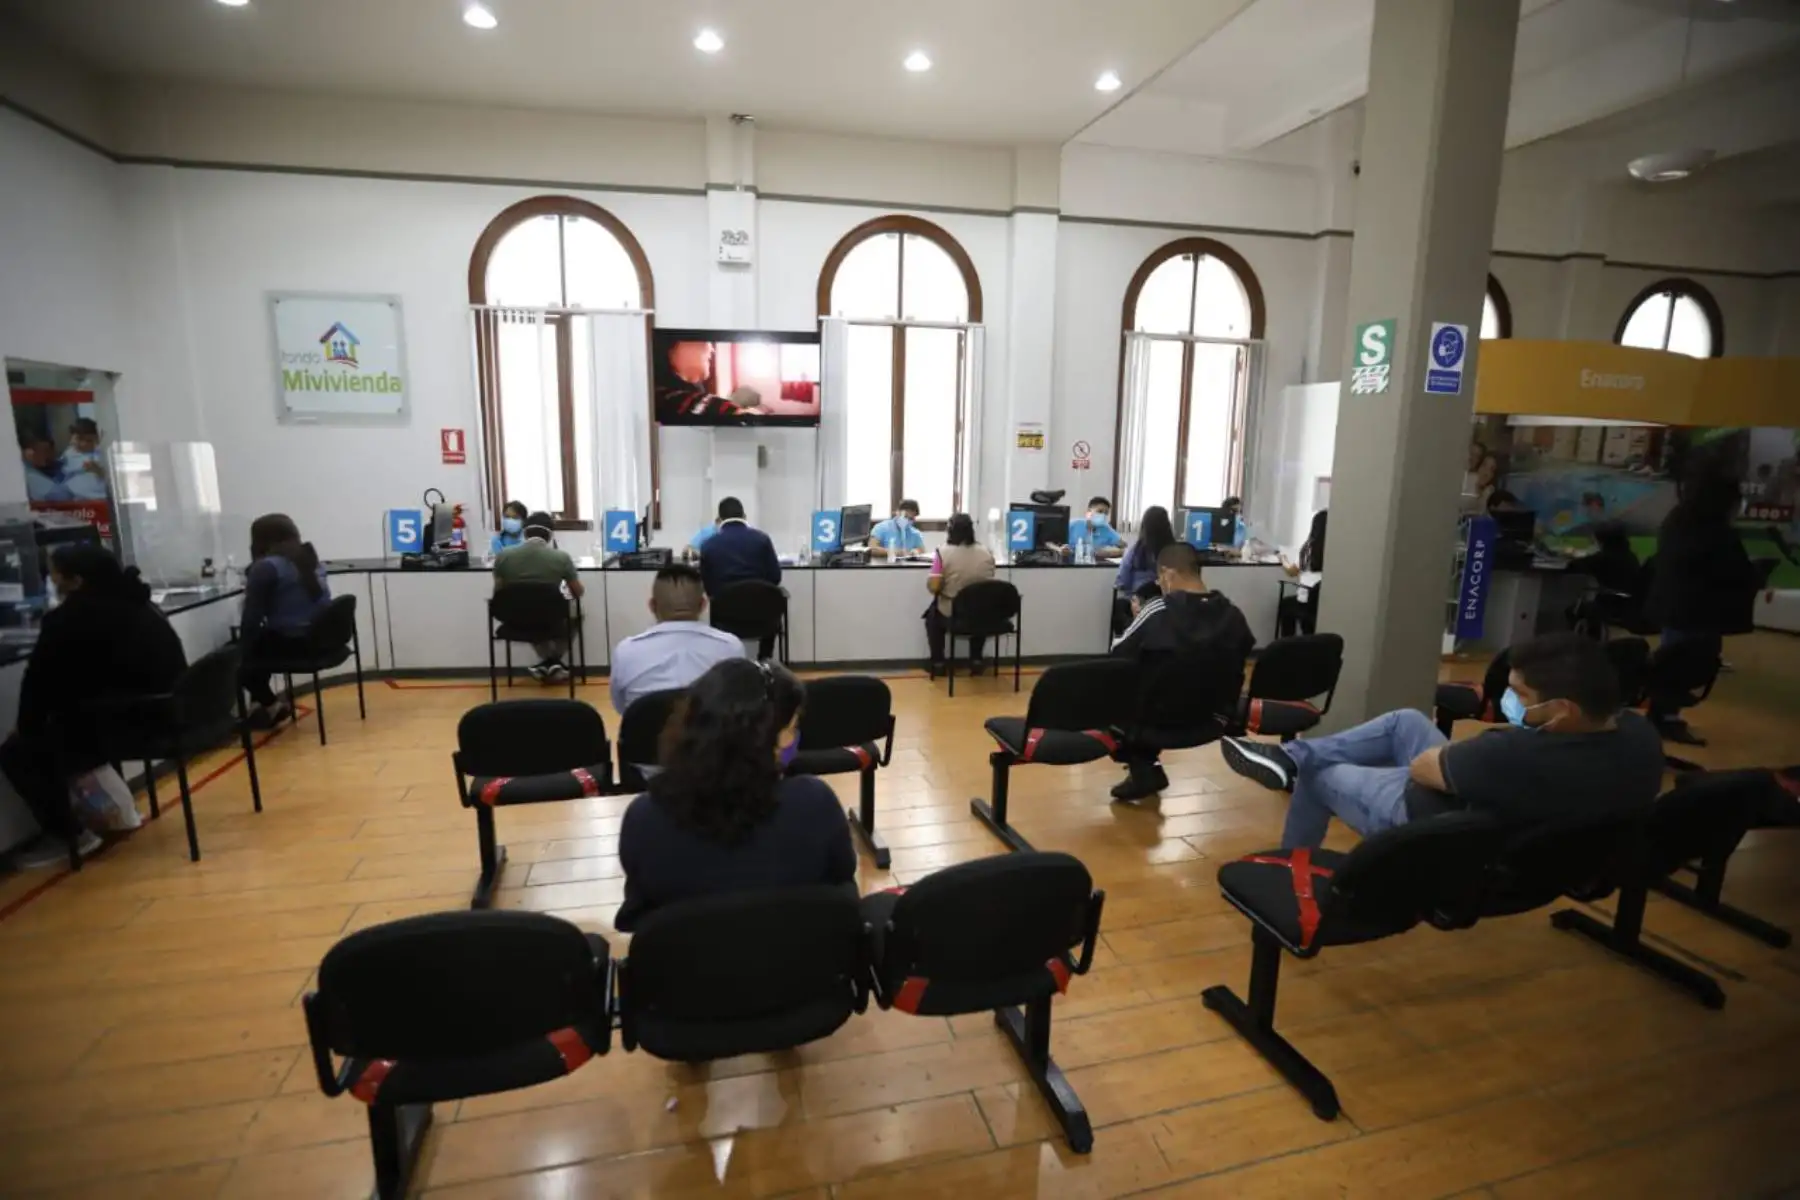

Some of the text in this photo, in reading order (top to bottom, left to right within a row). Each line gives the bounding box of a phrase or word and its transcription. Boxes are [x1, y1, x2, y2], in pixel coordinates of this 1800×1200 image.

[1361, 325, 1387, 365] S
[282, 369, 402, 393] Mivivienda
[396, 519, 417, 543] 5
[611, 519, 630, 544] 4
[817, 519, 837, 543] 3
[1011, 519, 1029, 541] 2
[1191, 520, 1204, 541] 1
[1464, 539, 1485, 620] ENACORP
